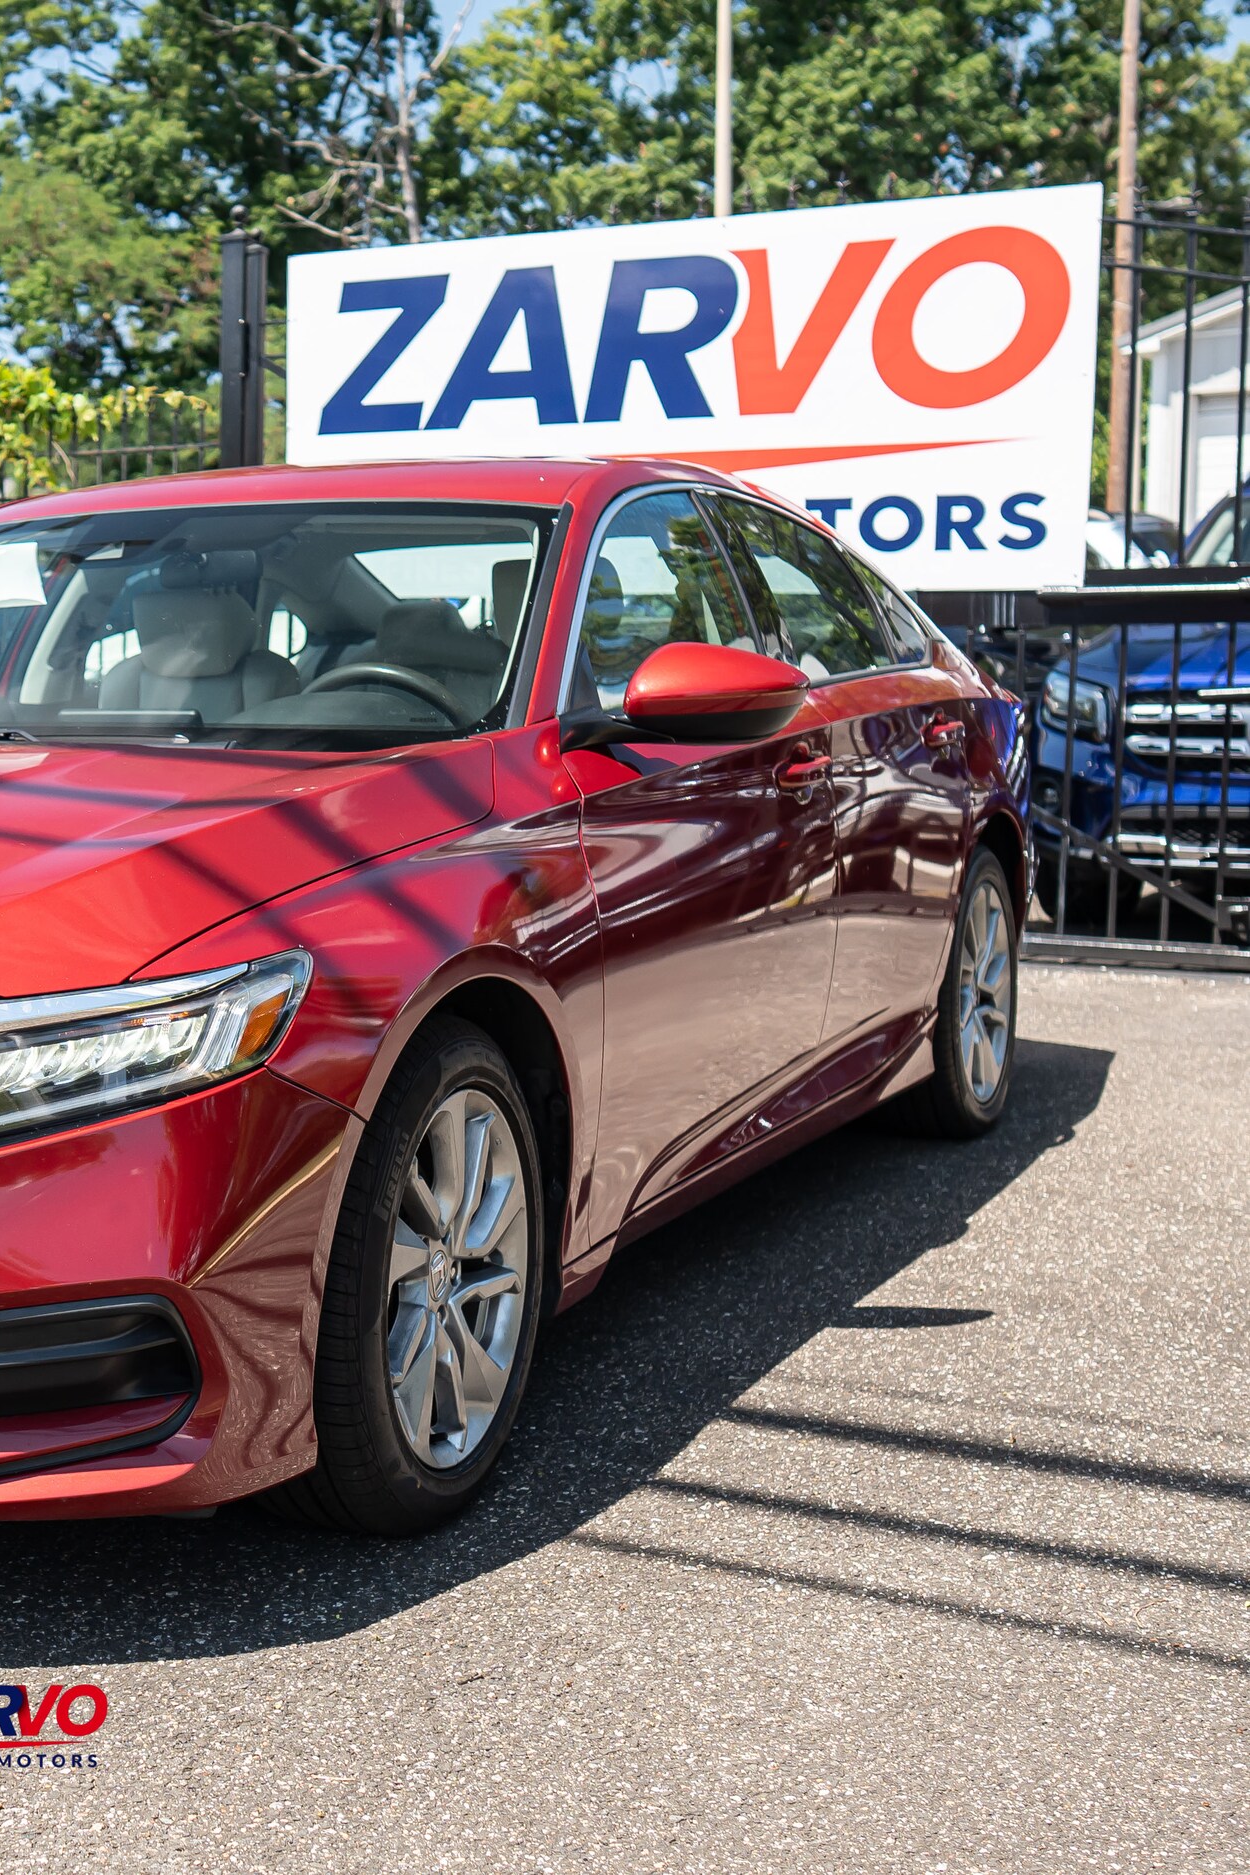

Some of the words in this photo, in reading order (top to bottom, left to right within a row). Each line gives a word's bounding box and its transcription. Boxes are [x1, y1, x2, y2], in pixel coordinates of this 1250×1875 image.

[317, 225, 1072, 436] ZARVO
[805, 492, 1048, 553] TORS
[372, 1128, 410, 1222] PIRELLI
